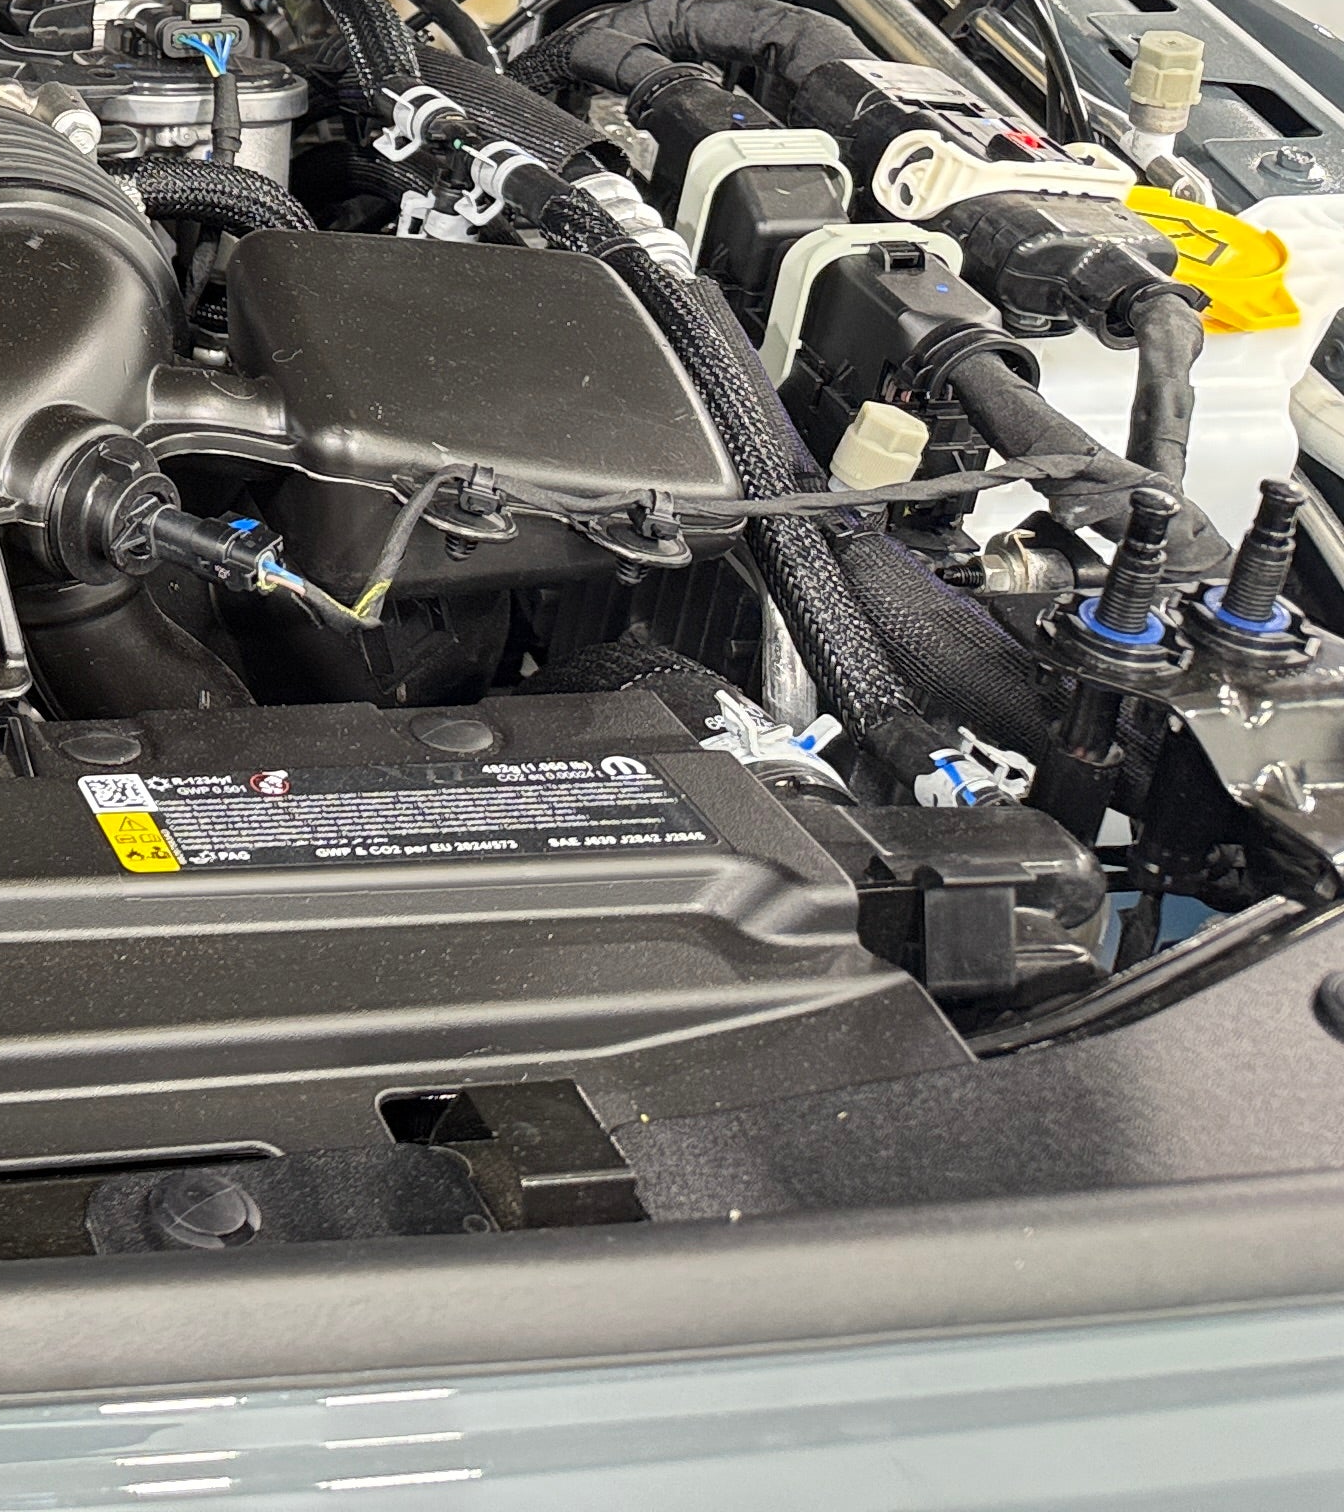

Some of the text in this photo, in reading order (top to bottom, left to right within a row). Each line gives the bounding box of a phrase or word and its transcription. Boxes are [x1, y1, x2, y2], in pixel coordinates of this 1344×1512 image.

[547, 836, 582, 847] SAE
[315, 847, 352, 857] GWP
[369, 845, 402, 855] CO2
[404, 845, 428, 855] per
[429, 842, 453, 853] EU
